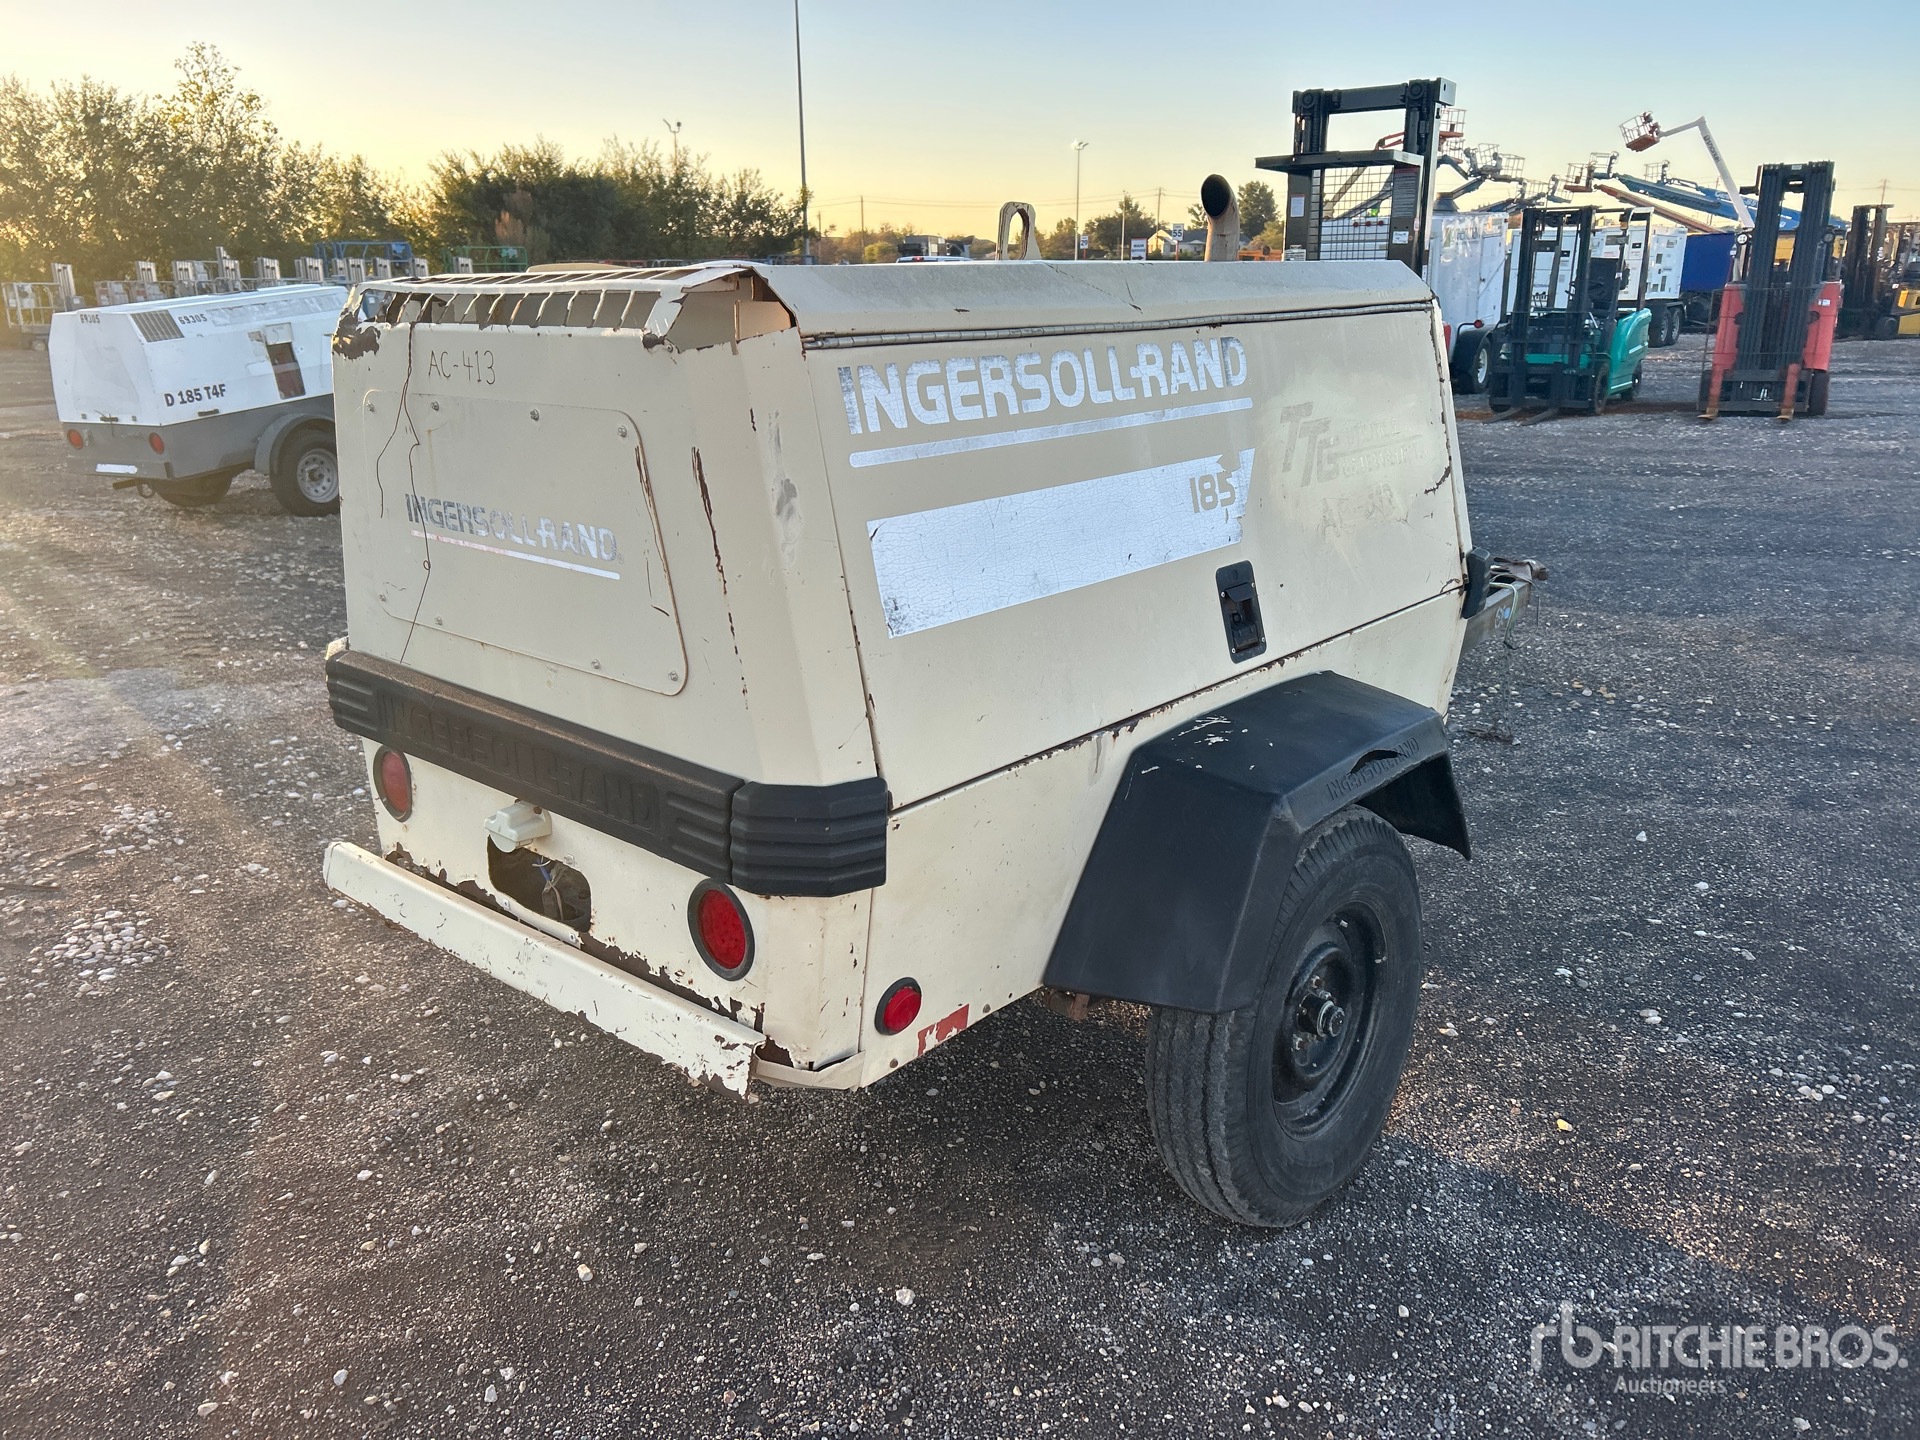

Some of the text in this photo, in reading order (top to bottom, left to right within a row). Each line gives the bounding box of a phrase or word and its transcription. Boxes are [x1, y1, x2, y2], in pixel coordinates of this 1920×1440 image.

[79, 313, 101, 324] 69305
[178, 313, 208, 325] 69305
[427, 349, 496, 385] AC-413
[164, 383, 226, 407] D 185 T4F
[1189, 470, 1236, 514] 185
